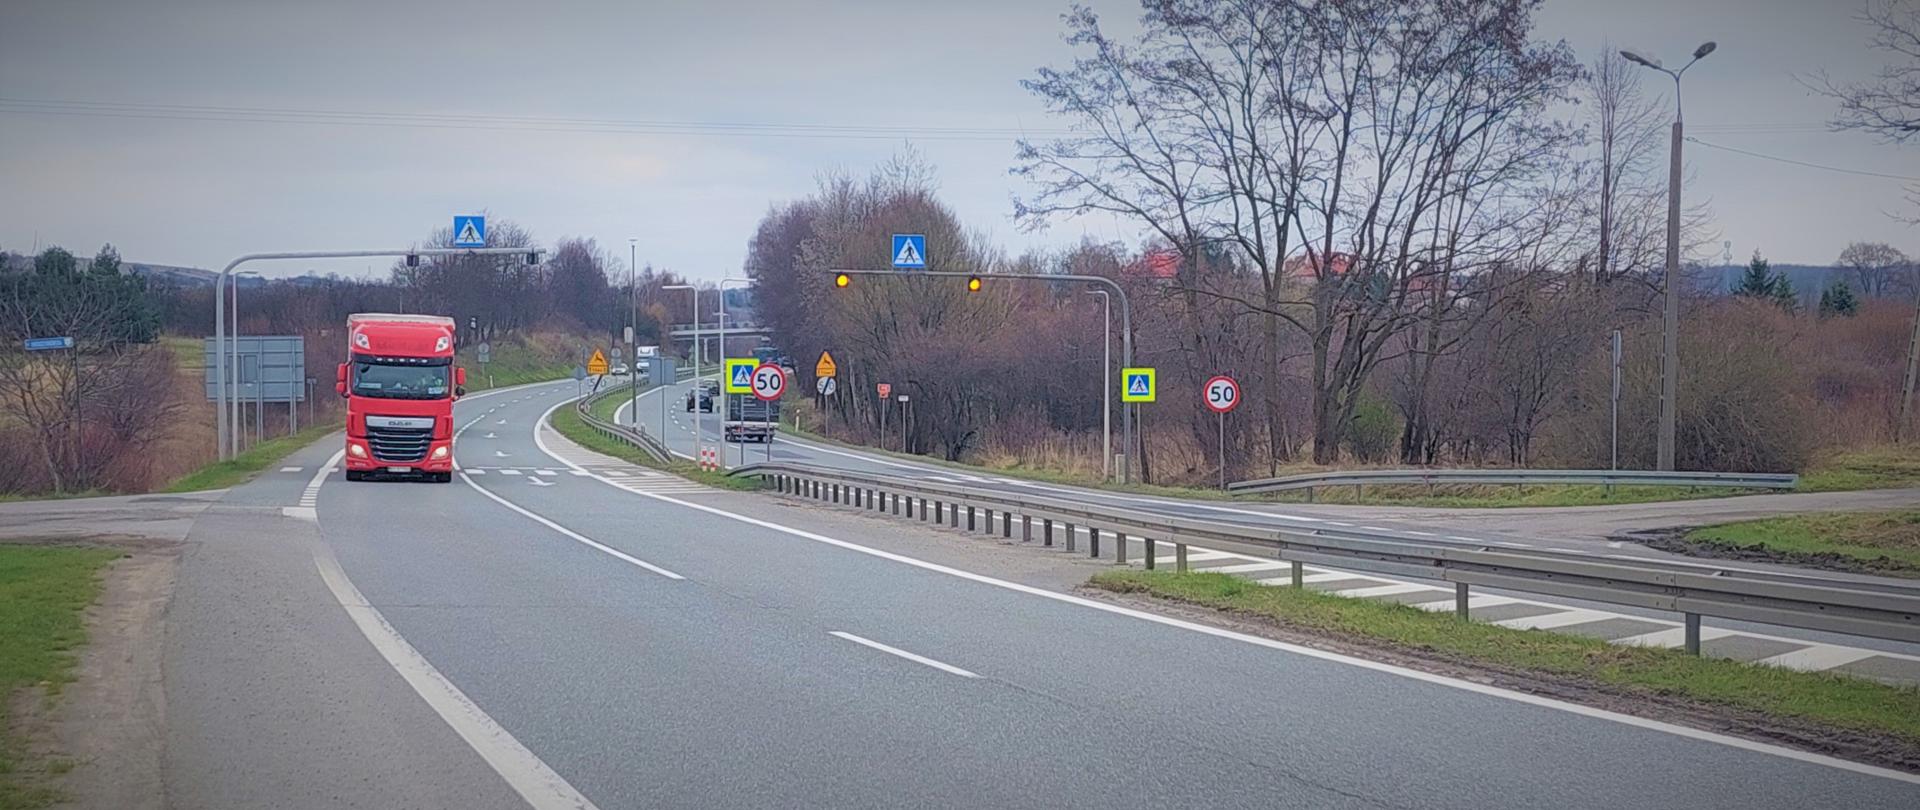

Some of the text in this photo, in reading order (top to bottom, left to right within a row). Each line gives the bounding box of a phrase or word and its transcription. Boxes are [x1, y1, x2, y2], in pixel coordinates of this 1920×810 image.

[588, 377, 607, 388] 50
[756, 373, 781, 391] 50
[818, 380, 835, 391] 50
[1210, 385, 1234, 402] 50
